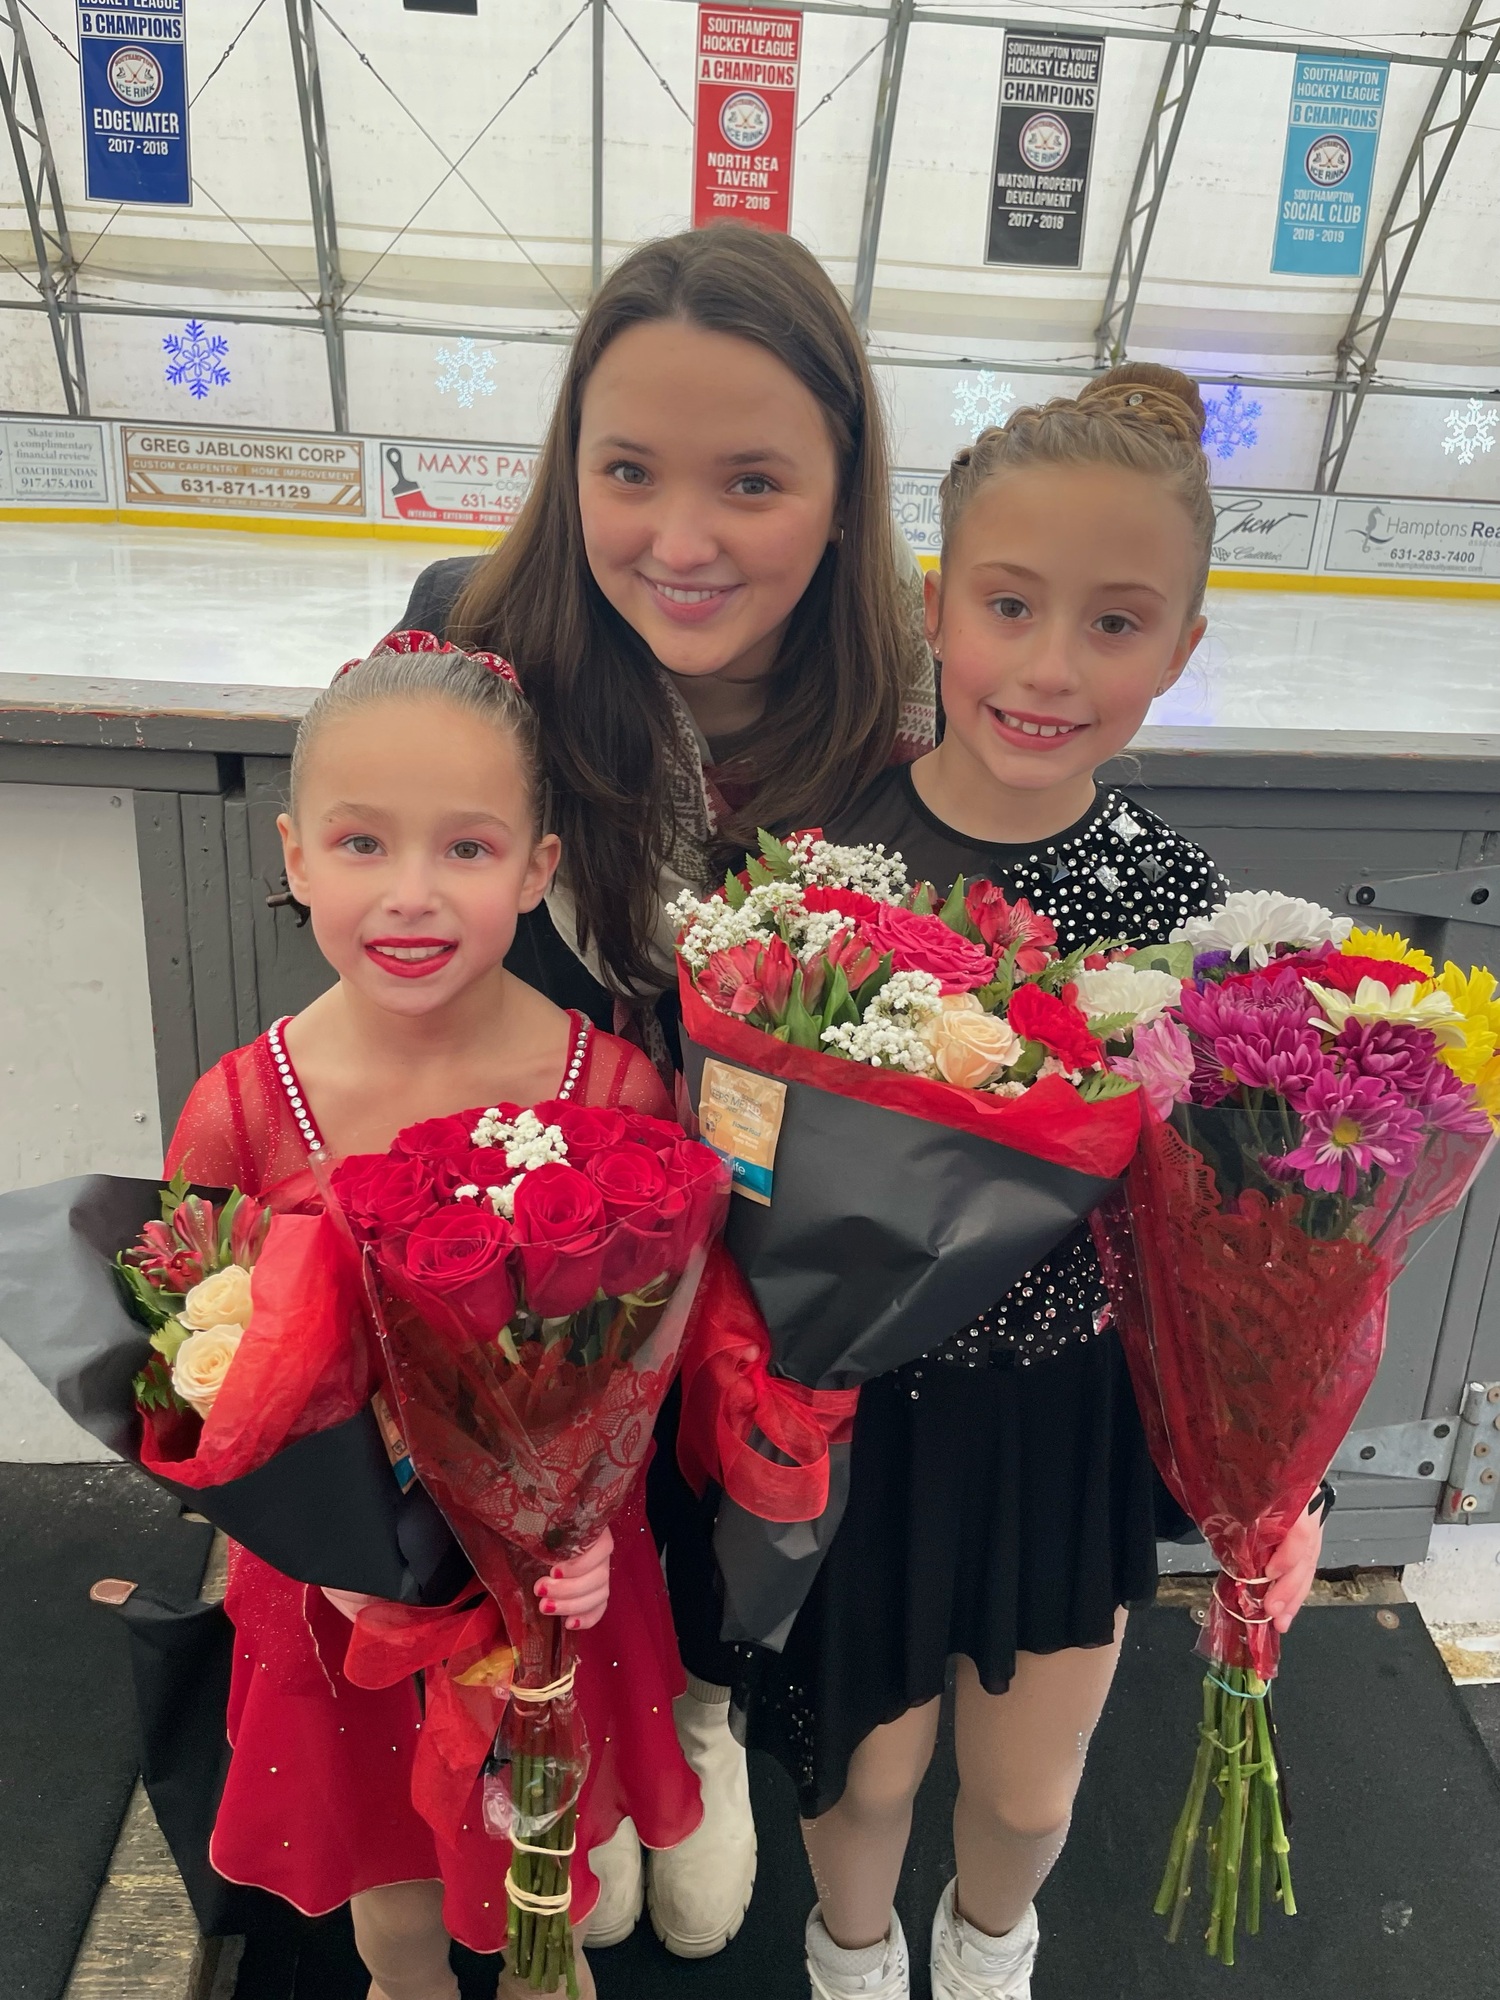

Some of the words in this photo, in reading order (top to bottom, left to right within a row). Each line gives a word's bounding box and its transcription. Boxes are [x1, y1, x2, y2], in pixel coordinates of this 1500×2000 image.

[83, 14, 92, 32] B
[96, 14, 181, 38] CHAMPIONS
[708, 17, 792, 38] SOUTHAMPTON
[702, 34, 750, 53] HOCKEY
[752, 39, 796, 57] LEAGUE
[1008, 42, 1070, 60] SOUTHAMPTON
[1071, 48, 1098, 62] YOUTH
[702, 59, 710, 78] A
[714, 60, 794, 86] CHAMPIONS
[1007, 57, 1052, 76] HOCKEY
[1054, 60, 1097, 80] LEAGUE
[1303, 66, 1379, 86] SOUTHAMPTON
[116, 80, 131, 96] ICE
[134, 82, 155, 98] RINK
[1004, 82, 1094, 107] CHAMPIONS
[1297, 82, 1340, 99] HOCKEY
[1341, 86, 1381, 102] LEAGUE
[94, 108, 180, 134] EDGEWATER
[1293, 104, 1302, 122] B
[1304, 105, 1378, 128] CHAMPIONS
[108, 138, 134, 154] 2017
[143, 140, 168, 156] 2018
[708, 152, 750, 170] NORTH
[754, 156, 778, 172] SEA
[1310, 164, 1324, 179] ICE
[1324, 166, 1345, 180] RINK
[716, 168, 768, 188] TAVERN
[997, 173, 1036, 189] WATSON
[1037, 176, 1084, 192] PROPERTY
[712, 193, 738, 208] 2017
[745, 195, 770, 210] 2018
[1005, 190, 1072, 208] DEVELOPMENT
[1294, 189, 1354, 204] SOUTHAMPTON
[1008, 212, 1034, 228] 2017
[1039, 214, 1064, 230] 2018
[1283, 201, 1325, 222] SOCIAL
[1329, 204, 1362, 224] CLUB
[1292, 228, 1314, 241] 2018
[1321, 229, 1344, 243] 2019
[28, 428, 54, 438] Skate
[55, 430, 75, 439] into
[16, 449, 56, 460] financial
[59, 452, 90, 461] review
[20, 439, 93, 452] complimentary
[140, 437, 190, 454] GREG
[196, 441, 292, 460] JABLONSKI
[298, 448, 346, 464] CORP
[14, 466, 50, 476] COACH
[51, 468, 98, 477] BRENDAN
[133, 460, 176, 470] CUSTOM
[178, 462, 239, 474] CARPENTRY
[251, 467, 281, 477] HOME
[283, 469, 355, 481] IMPROVEMENT
[417, 452, 488, 476] MAX'S
[180, 478, 310, 499] 631-871-1129
[1386, 516, 1468, 538] Hamptons
[1390, 548, 1475, 562] 631-283-7400
